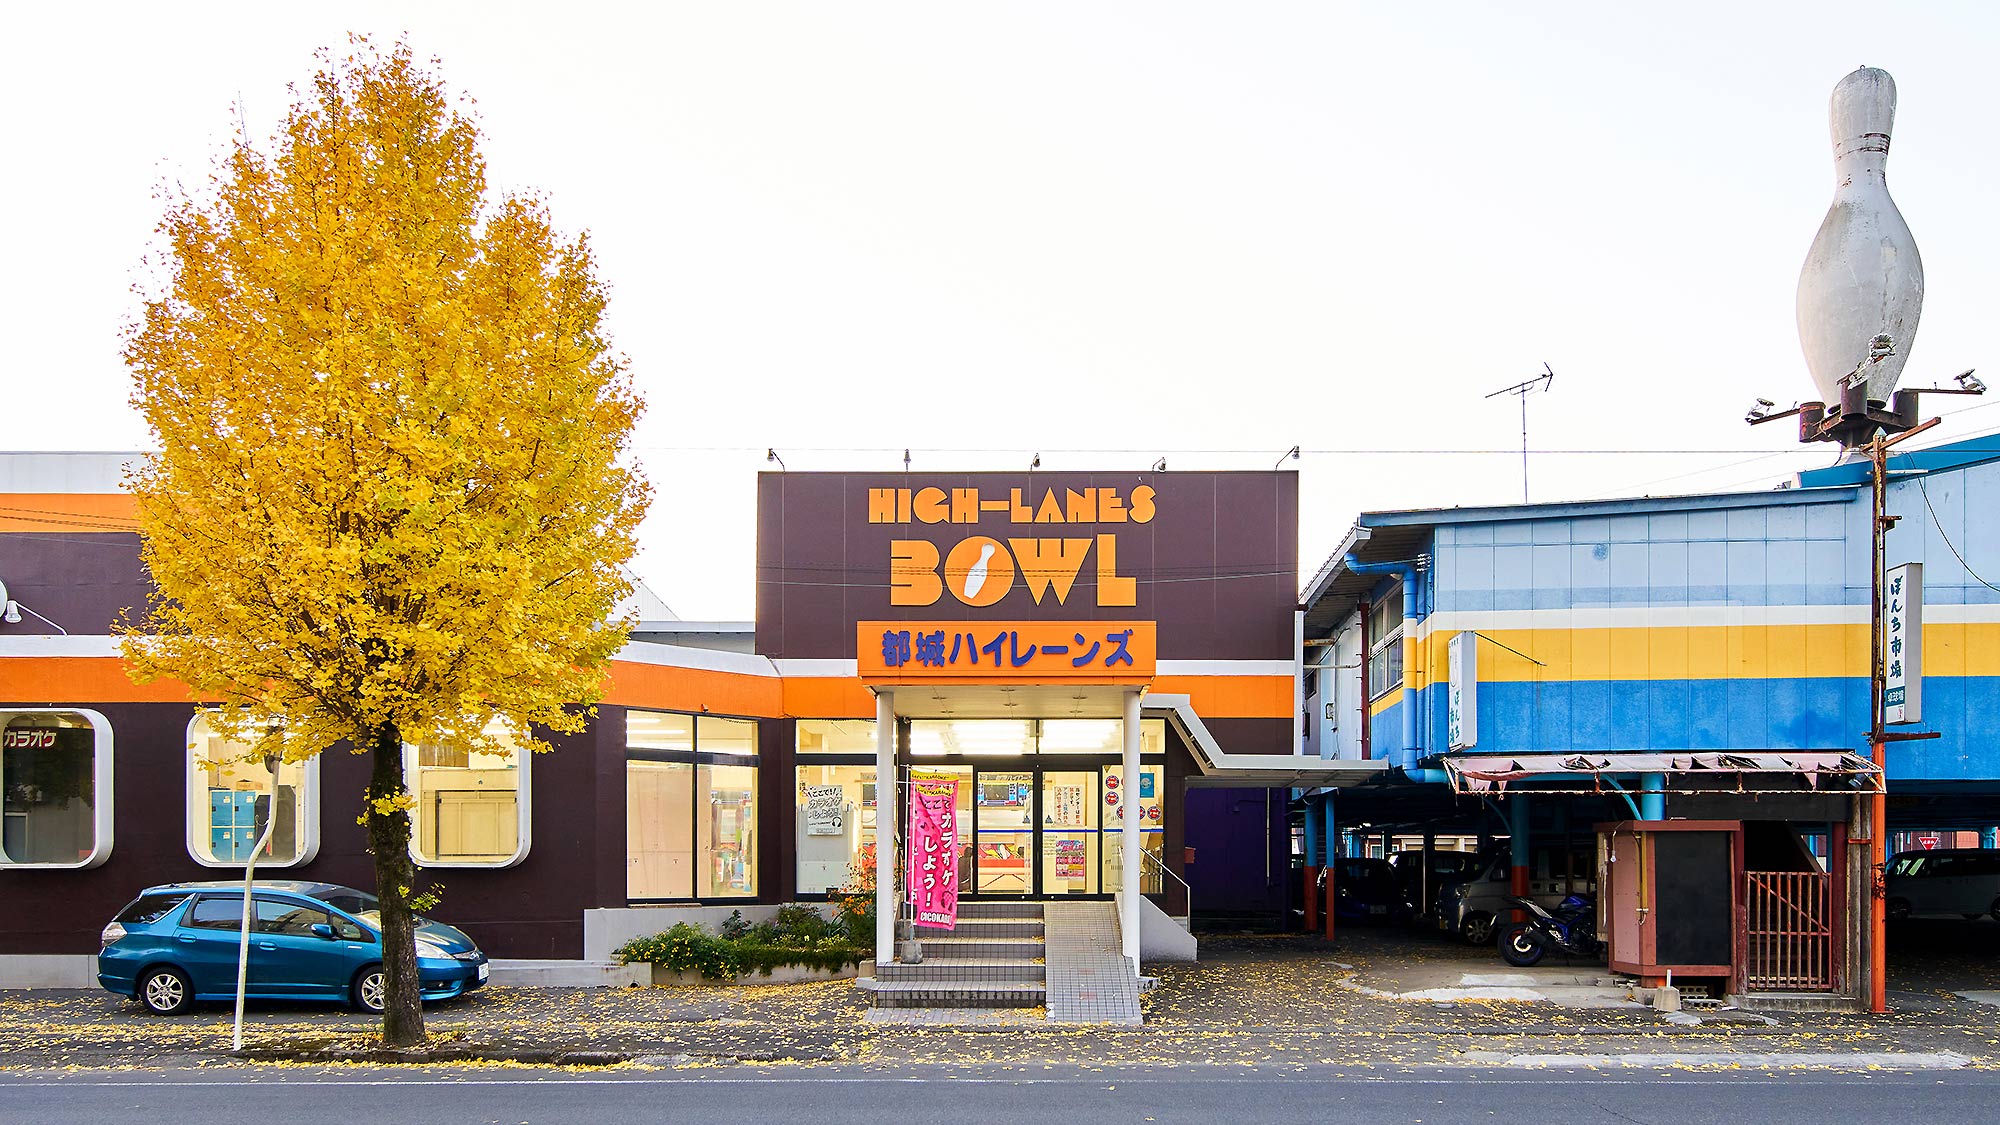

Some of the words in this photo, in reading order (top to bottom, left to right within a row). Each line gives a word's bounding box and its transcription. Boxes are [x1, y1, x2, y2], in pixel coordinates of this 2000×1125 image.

[868, 485, 1157, 524] HIGH-LANES
[890, 534, 1137, 607] BOWL
[881, 629, 1135, 668] 都城ハイレーンズ
[4, 730, 57, 748] カラオケ
[940, 812, 954, 887] カラオケ
